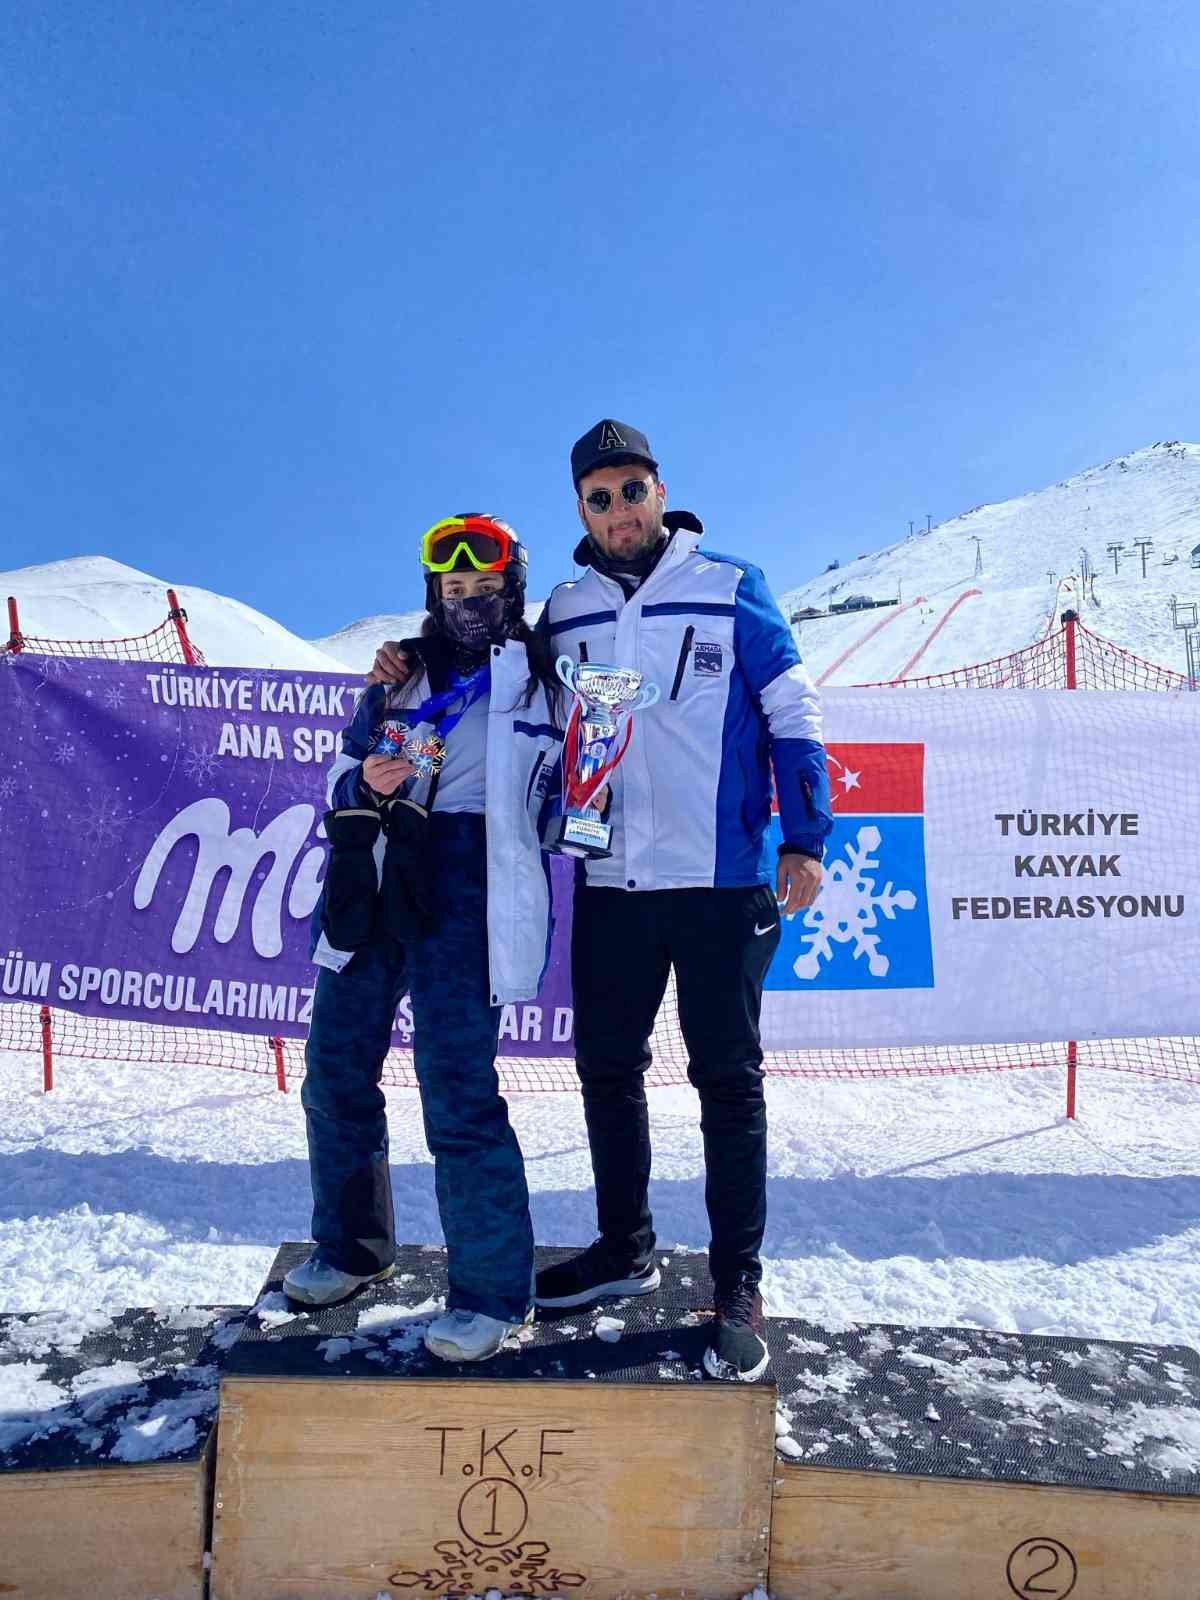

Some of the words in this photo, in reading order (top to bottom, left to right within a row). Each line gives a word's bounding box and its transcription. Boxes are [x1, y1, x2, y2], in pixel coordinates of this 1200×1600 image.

[599, 423, 627, 450] A
[146, 668, 253, 711] TÜRKİYE
[261, 676, 345, 717] KAYAK
[217, 722, 285, 760] ANA
[994, 808, 1139, 836] TÜRKİYE
[1014, 855, 1122, 877] KAYAK
[951, 895, 1185, 920] FEDERASYONU
[0, 950, 52, 997] ÜM
[484, 1486, 503, 1535] 1
[1023, 1545, 1060, 1593] 2
